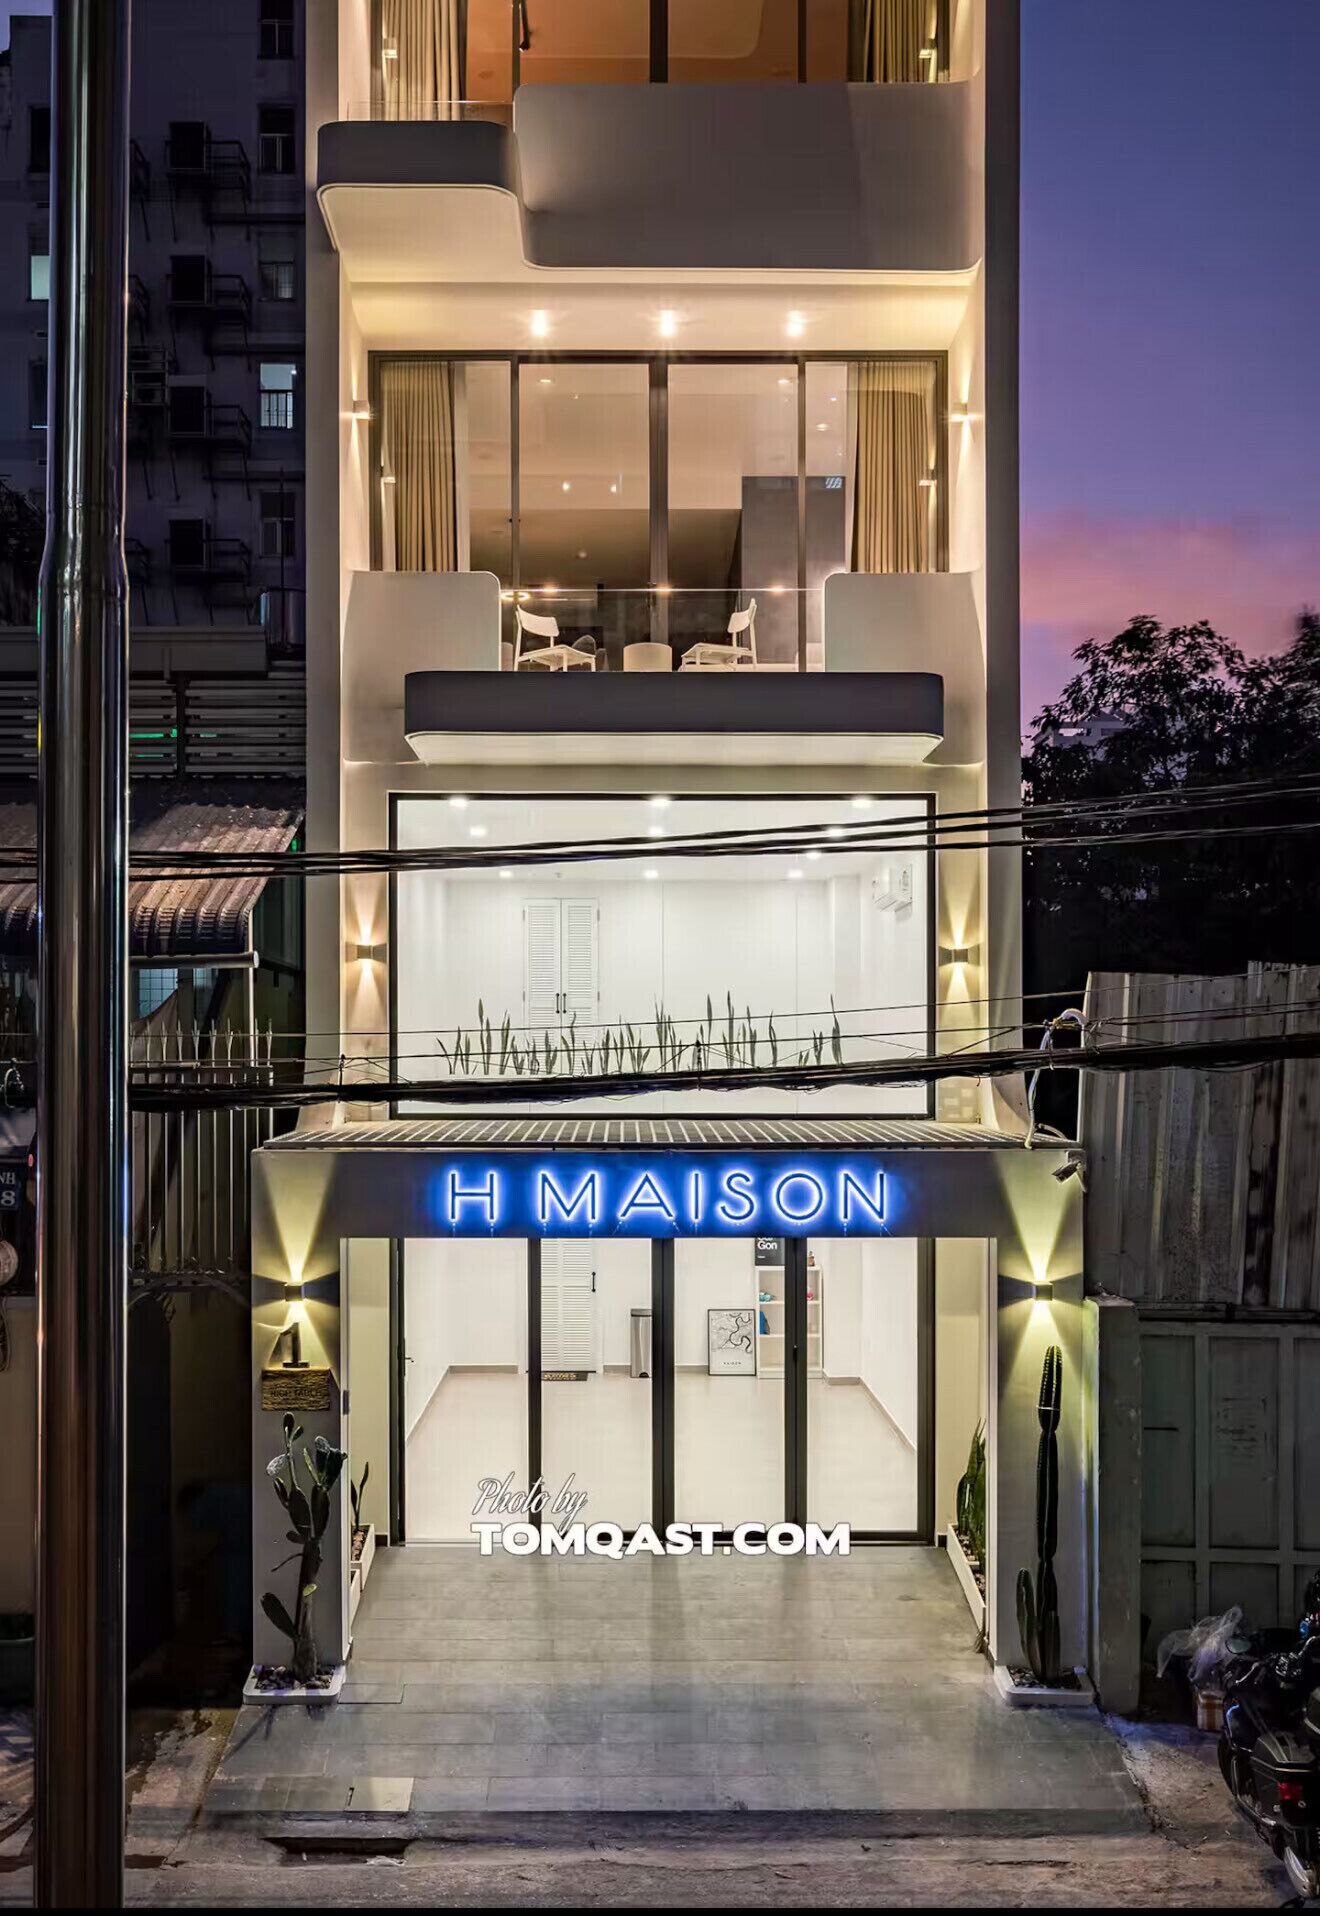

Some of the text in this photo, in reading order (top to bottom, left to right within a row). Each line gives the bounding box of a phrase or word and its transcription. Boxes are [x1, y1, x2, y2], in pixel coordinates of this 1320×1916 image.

[450, 1171, 886, 1222] H MAISON
[757, 1240, 778, 1250] Gon
